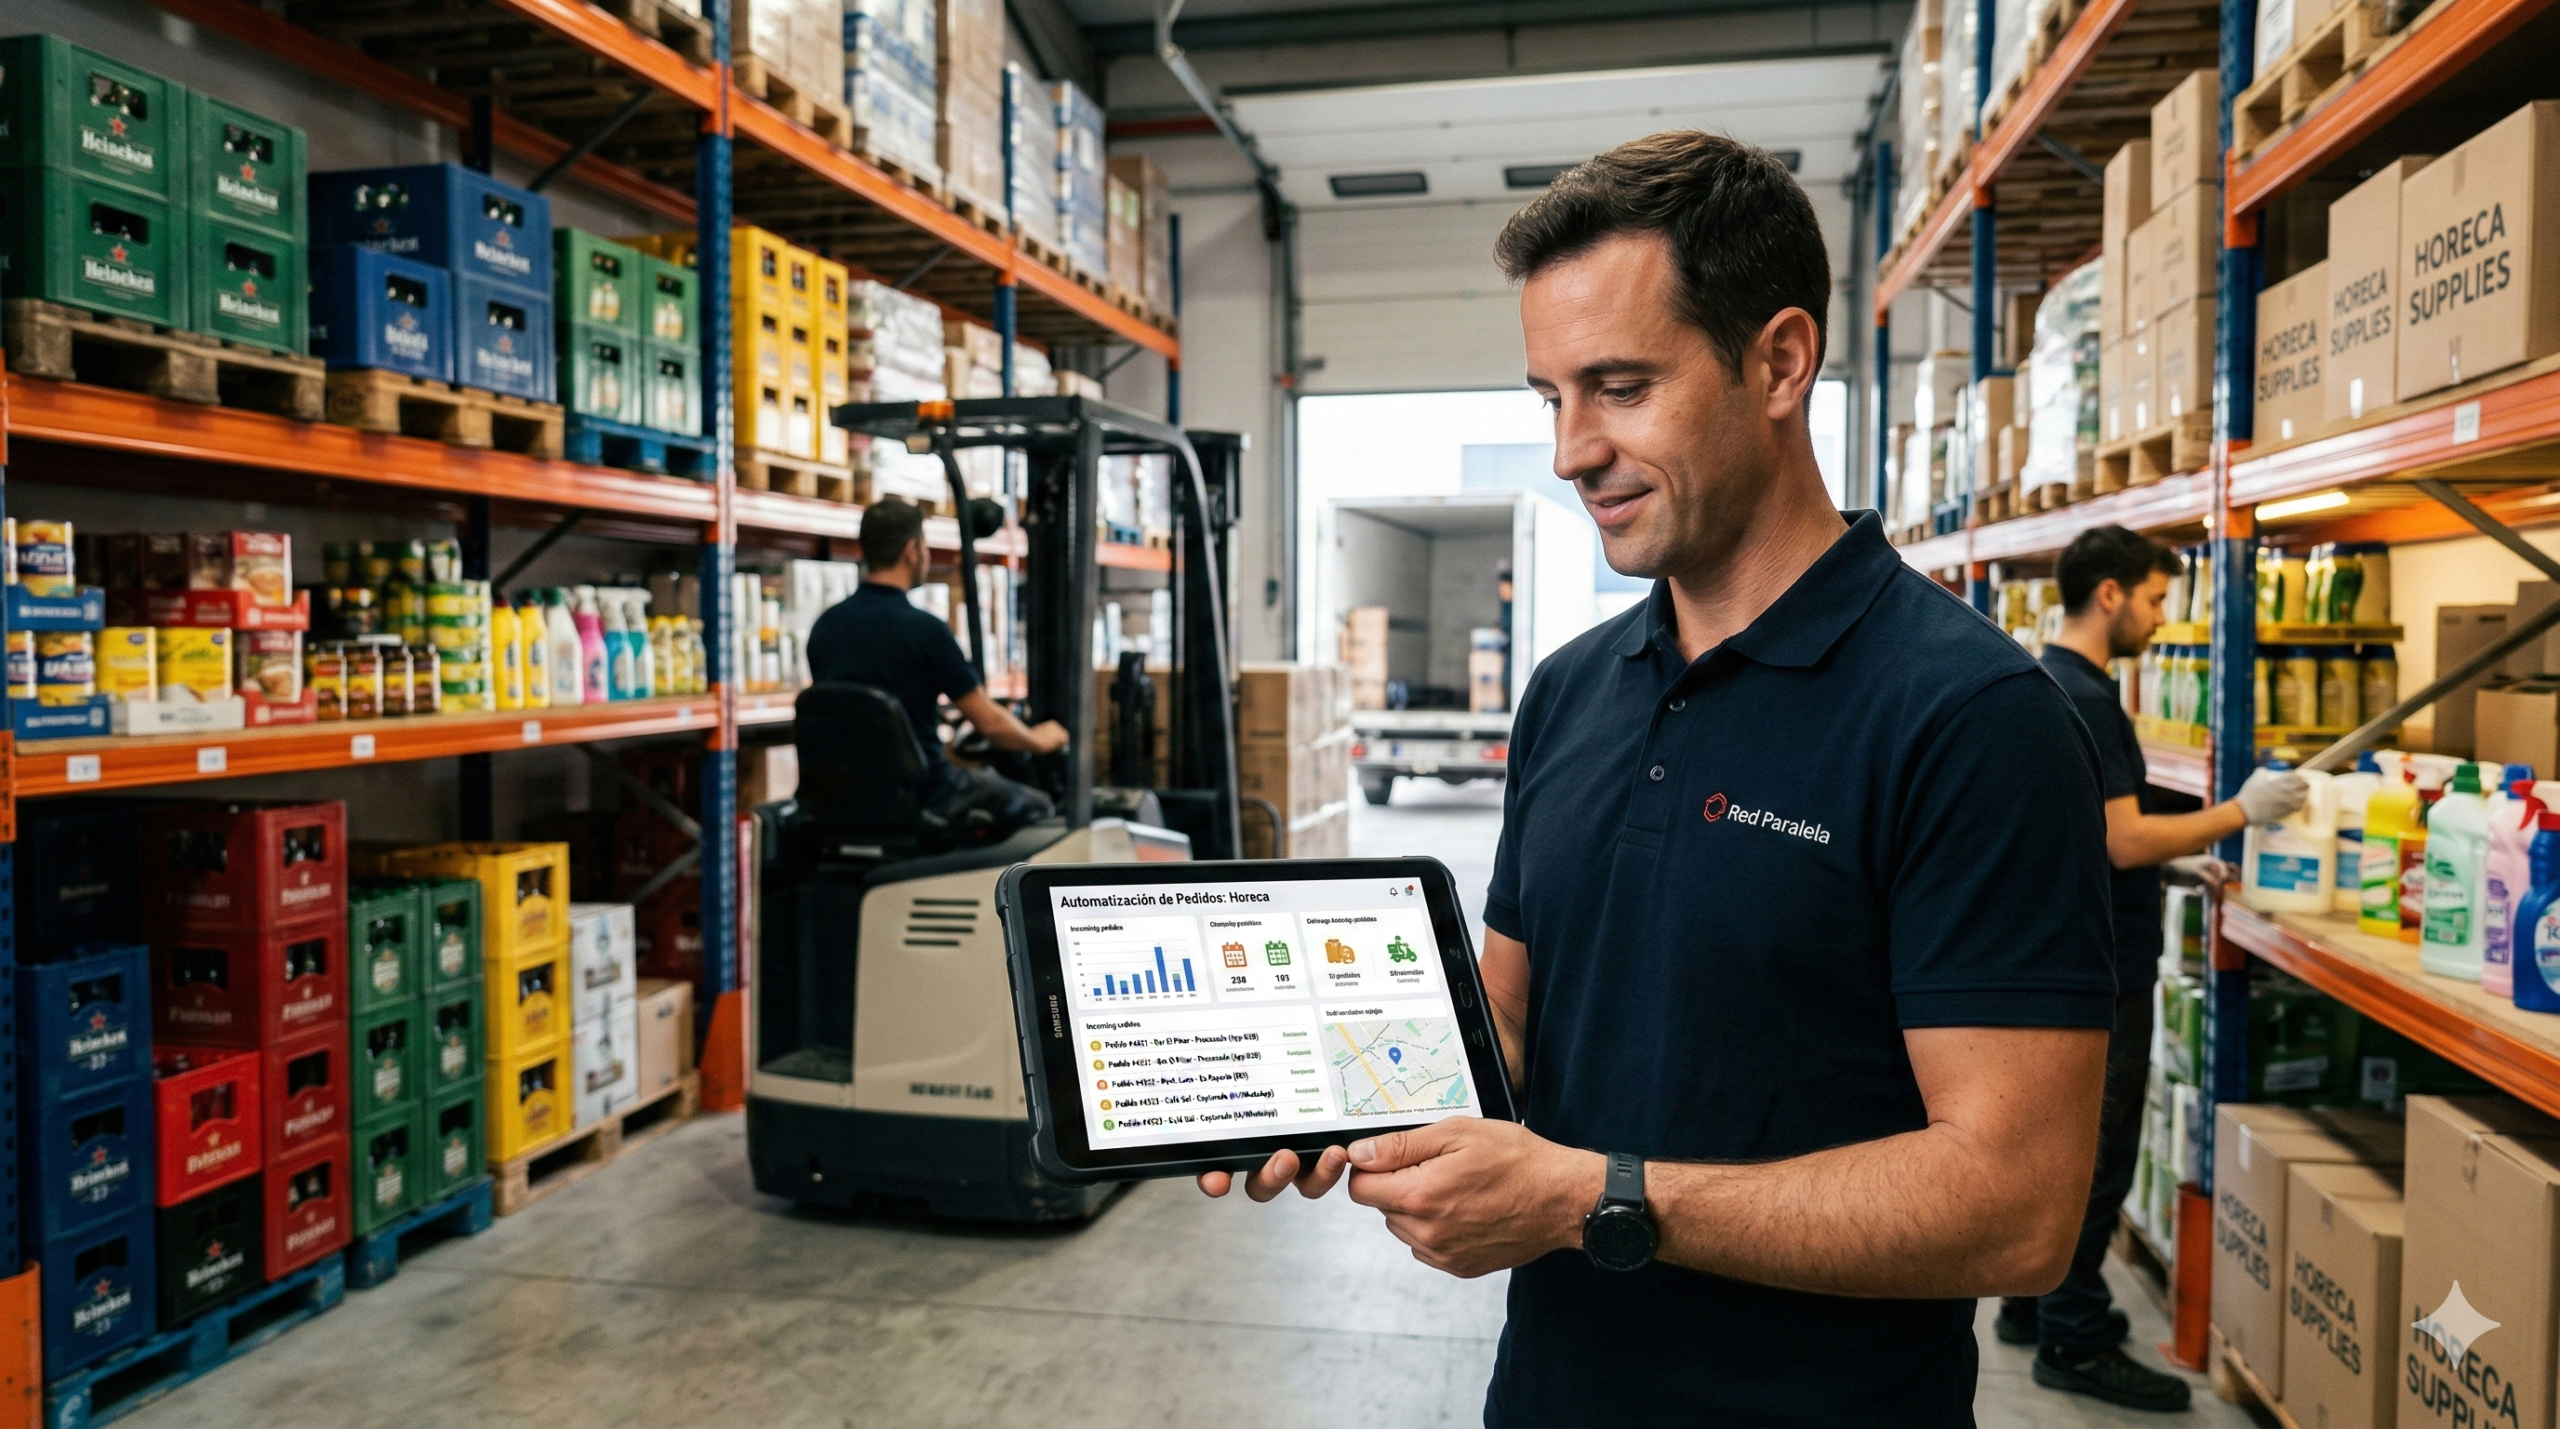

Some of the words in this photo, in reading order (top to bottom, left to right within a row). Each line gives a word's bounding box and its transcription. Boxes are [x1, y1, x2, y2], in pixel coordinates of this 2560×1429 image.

[81, 128, 154, 169] Heineken
[2415, 202, 2506, 278] HORECA
[84, 259, 155, 293] Heineken
[2333, 267, 2389, 320] HORECA
[2409, 250, 2511, 326] SUPPLIES
[2262, 319, 2318, 364] HORECA
[2330, 305, 2391, 357] SUPPLIES
[2258, 355, 2321, 402] SUPPLIES
[1727, 804, 1761, 825] Red
[1761, 811, 1831, 844] Paralela
[1060, 893, 1156, 908] Automatización
[1159, 893, 1174, 905] de
[1176, 891, 1227, 905] Pedidos:
[1229, 891, 1270, 903] Horeca
[1049, 995, 1063, 1038] SAMSUNG
[70, 1029, 128, 1057] Heineken
[71, 1159, 130, 1192] Heineken
[2220, 1186, 2268, 1252] HORECA
[186, 1252, 244, 1289] Heineken
[2217, 1217, 2271, 1291] SUPPLIES
[73, 1291, 132, 1330] Heineken
[2295, 1251, 2358, 1332] HORECA
[2290, 1285, 2362, 1376] SUPPLIES
[2414, 1305, 2519, 1429] HORECA
[2407, 1353, 2497, 1429] SUPP
